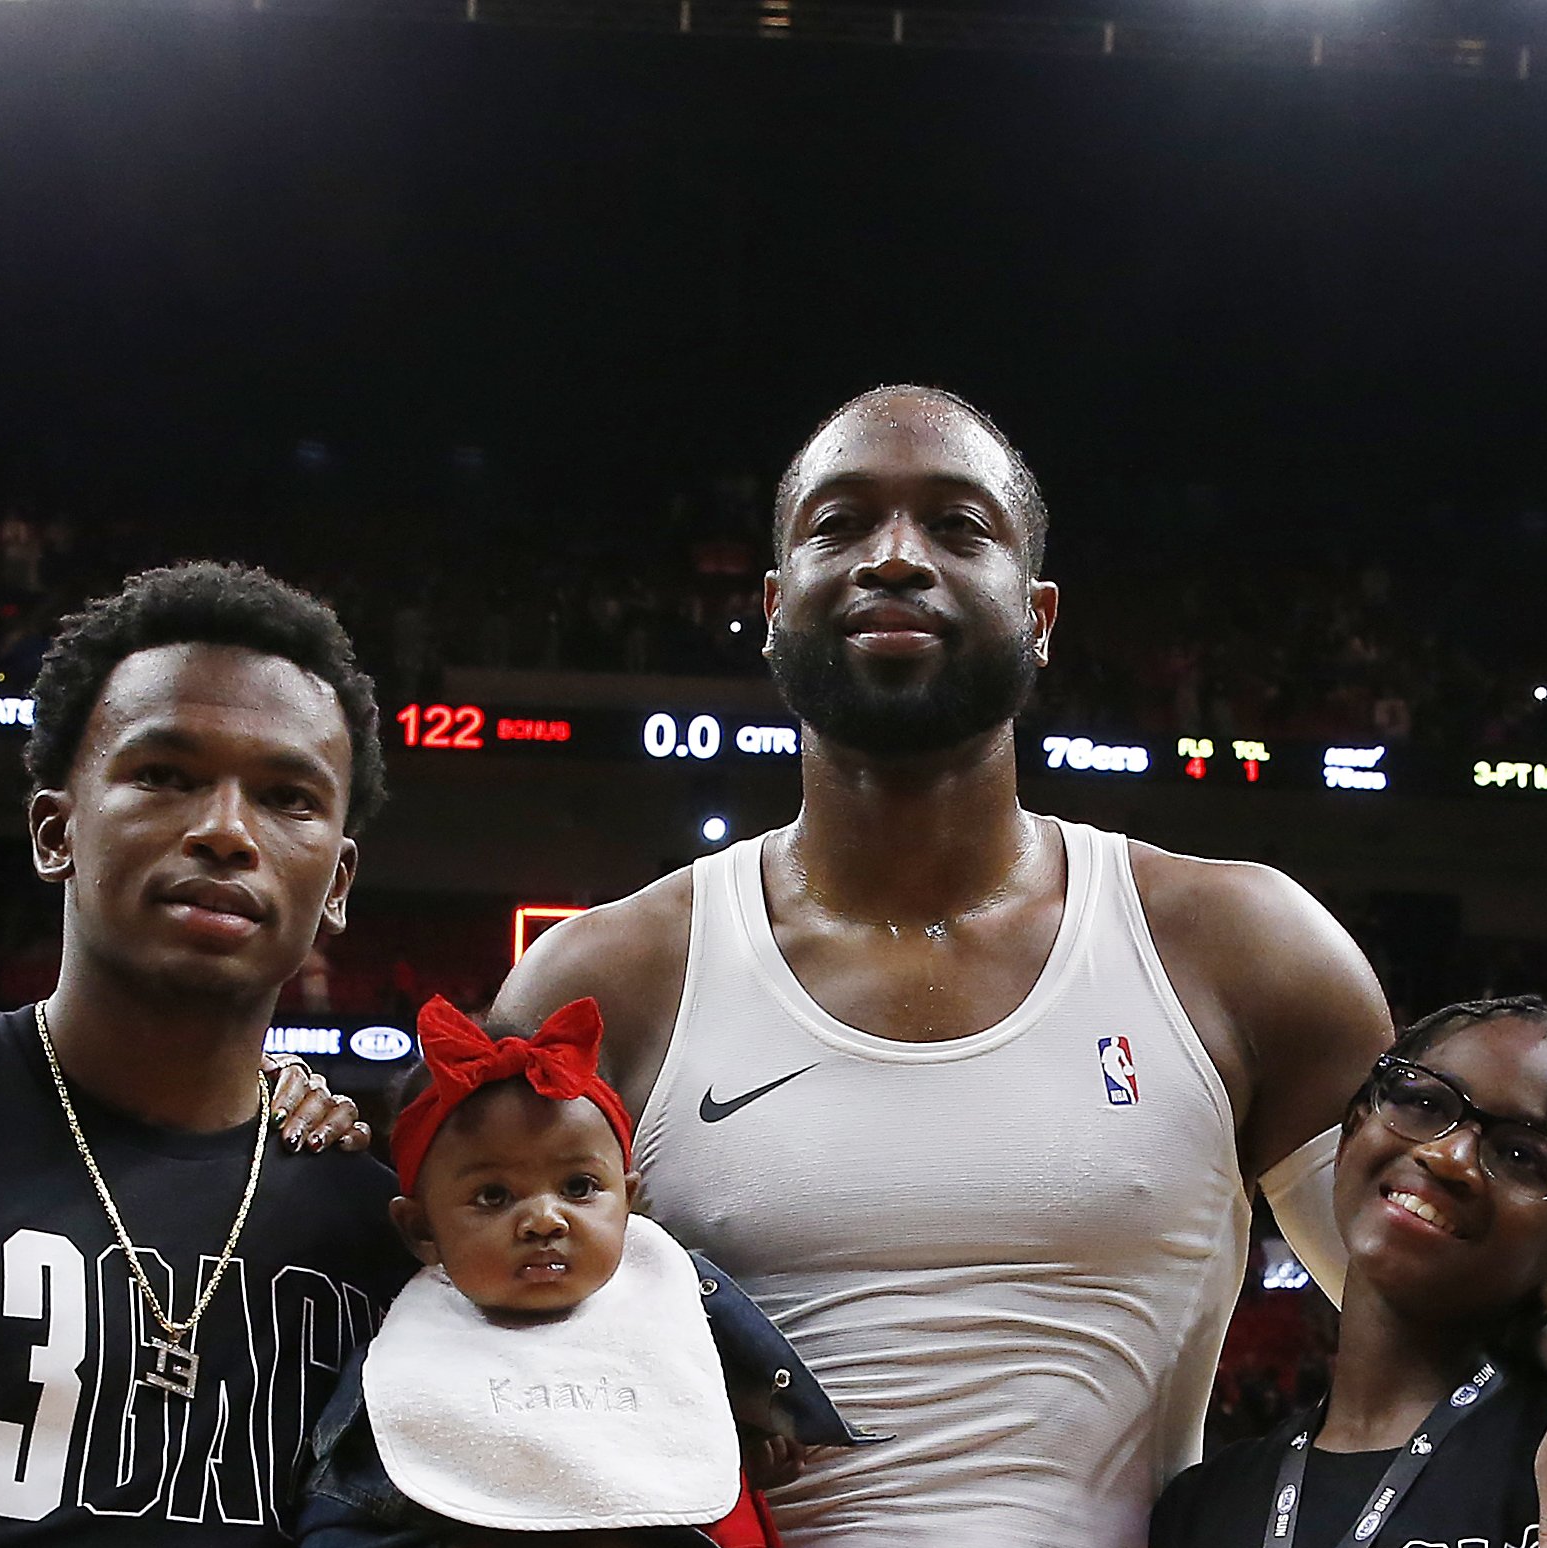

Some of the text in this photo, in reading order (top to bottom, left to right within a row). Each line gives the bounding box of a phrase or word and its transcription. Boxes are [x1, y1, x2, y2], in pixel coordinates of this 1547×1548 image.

[396, 703, 485, 750] 122
[642, 712, 798, 760] 0.0 QTR
[1041, 735, 1151, 773] 76ers
[1473, 760, 1532, 790] 3-PT
[1472, 1362, 1496, 1387] SUN
[488, 1376, 641, 1414] Kaavia
[1373, 1487, 1396, 1512] SUN
[1274, 1514, 1289, 1538] SUN
